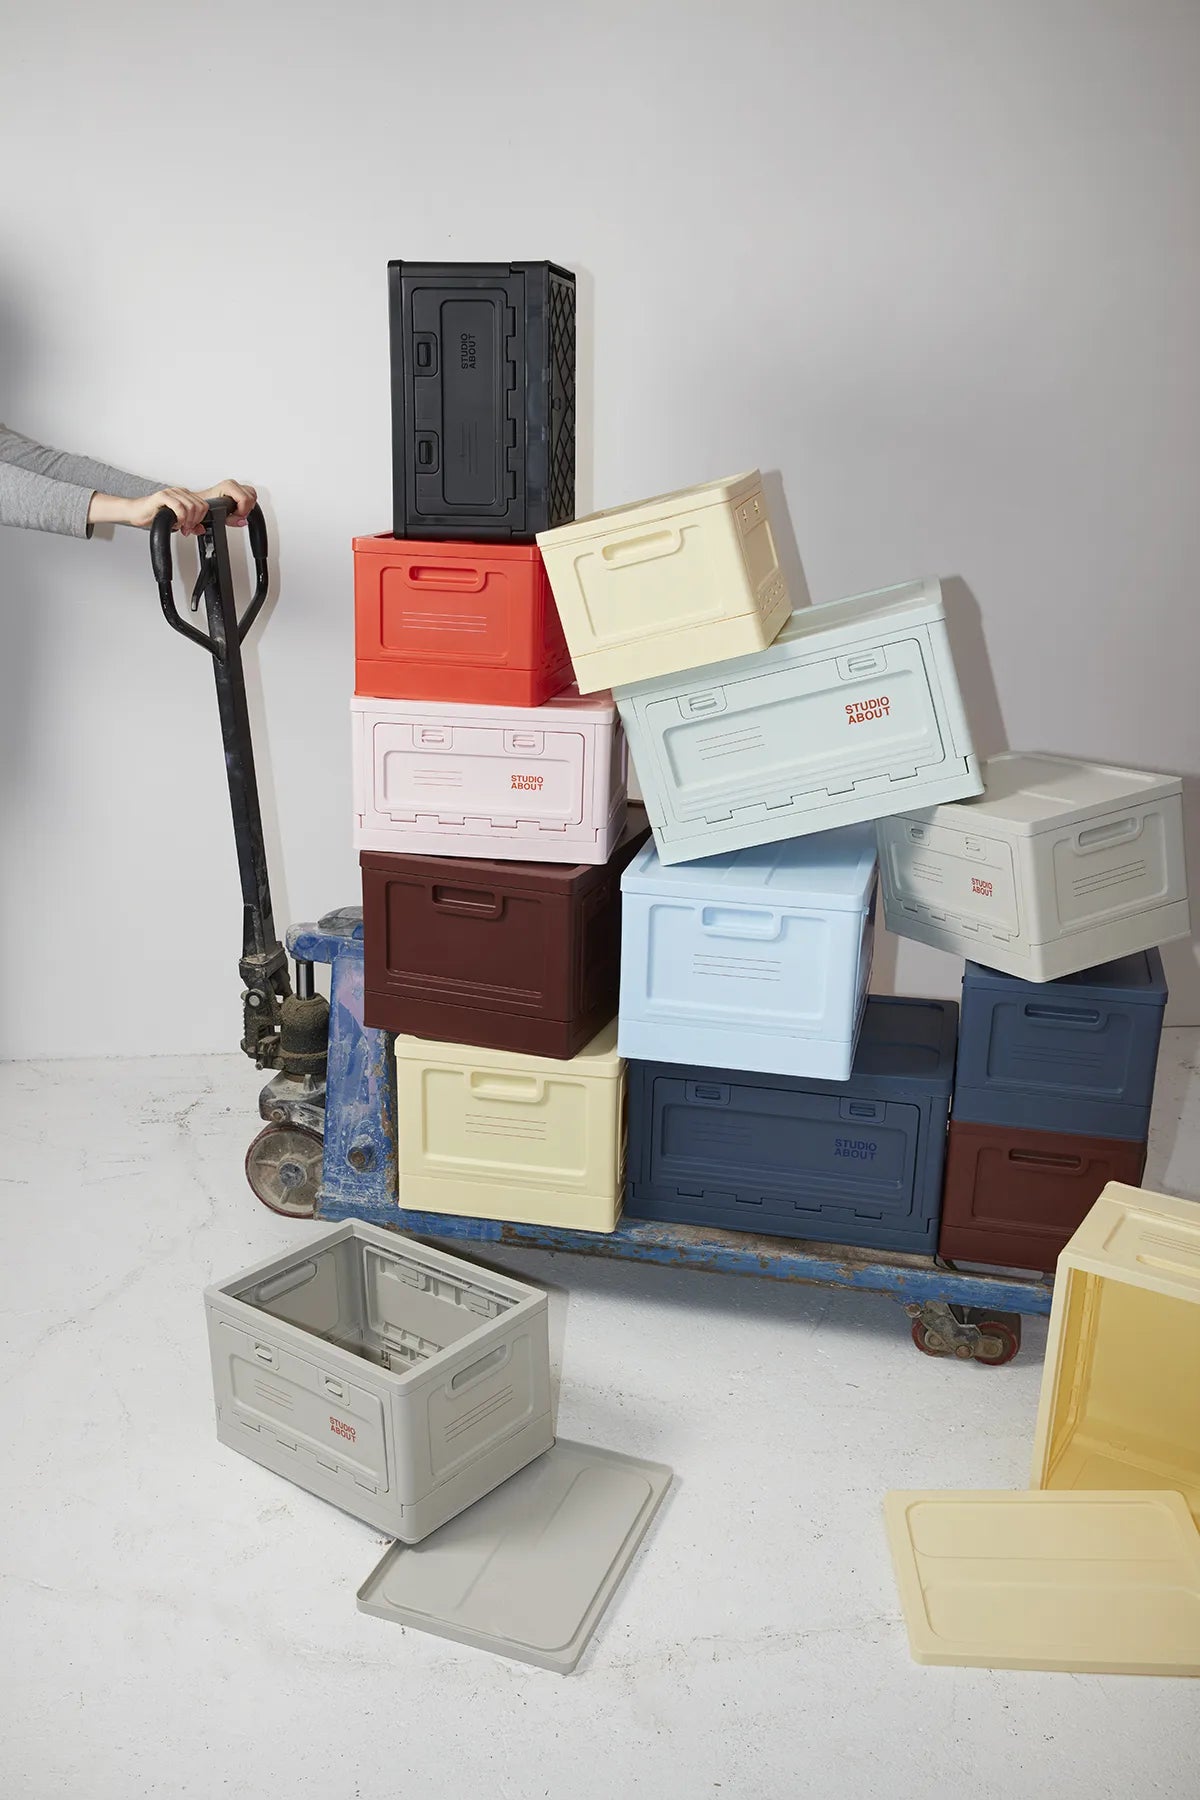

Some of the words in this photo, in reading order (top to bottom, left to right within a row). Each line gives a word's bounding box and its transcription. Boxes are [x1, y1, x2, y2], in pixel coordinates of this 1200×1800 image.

[460, 333, 468, 369] STUDIO
[468, 333, 476, 369] ABOUT
[845, 696, 889, 714] STUDIO
[848, 706, 890, 724] ABOUT
[511, 774, 544, 783] STUDIO
[511, 782, 543, 790] ABOUT
[971, 877, 992, 889] STUDIO
[972, 886, 992, 897] ABOUT
[834, 1138, 877, 1151] STUDIO
[833, 1148, 876, 1160] ABOUT
[329, 1416, 356, 1435] STUDIO
[330, 1424, 356, 1442] ABOUT
